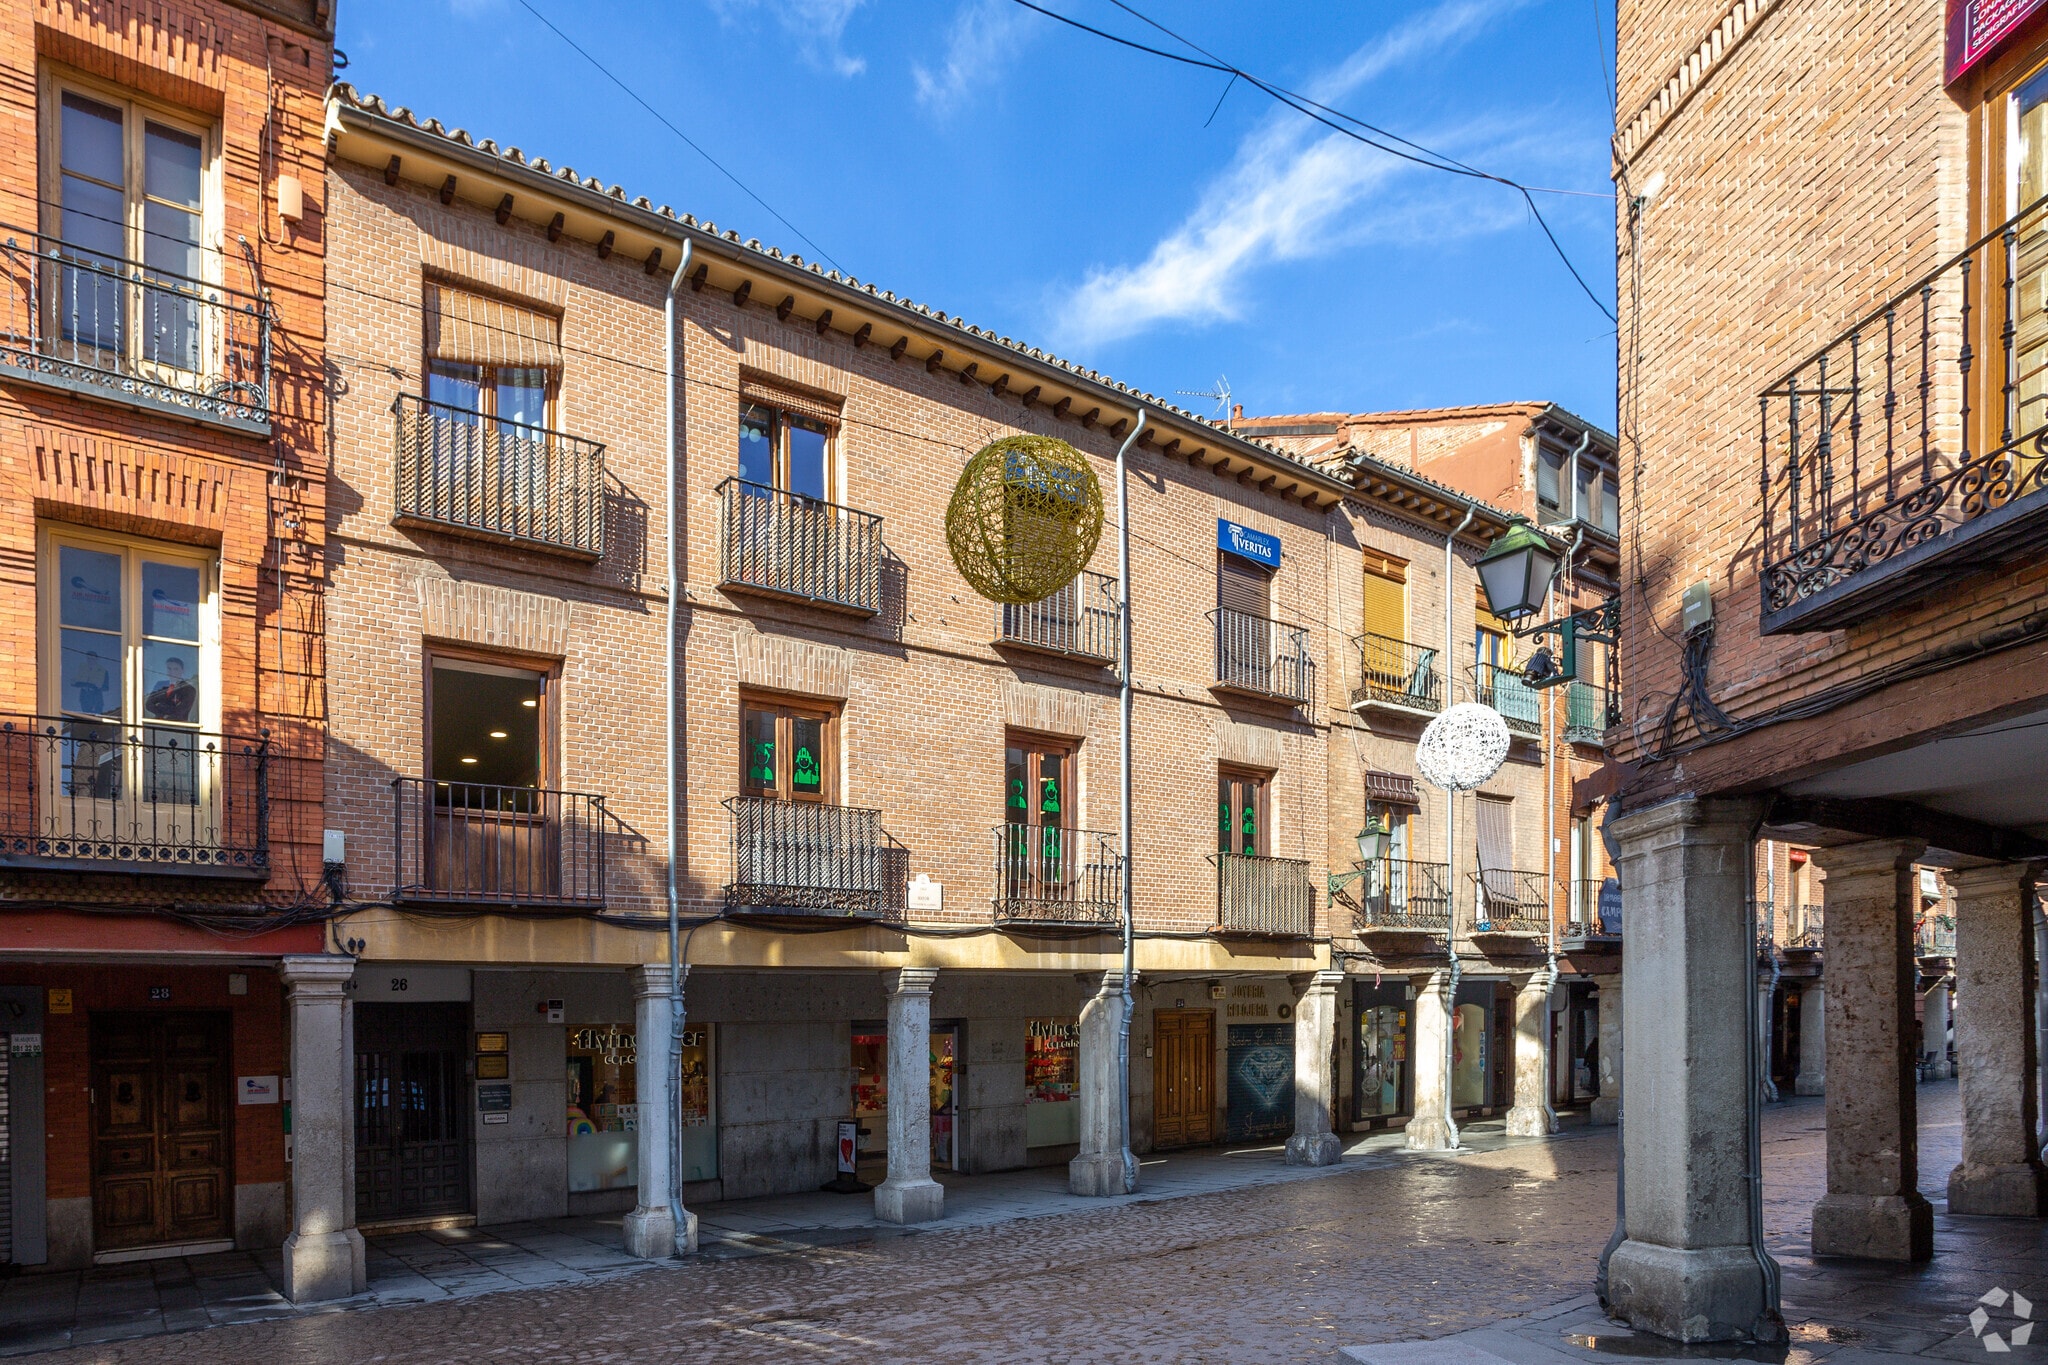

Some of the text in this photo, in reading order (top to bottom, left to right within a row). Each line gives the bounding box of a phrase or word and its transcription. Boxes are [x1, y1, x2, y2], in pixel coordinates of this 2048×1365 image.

[1239, 538, 1271, 558] VERITAS
[1601, 906, 1622, 918] CAMP
[391, 978, 408, 991] 26
[151, 987, 170, 999] 28
[577, 1029, 637, 1055] flyin
[605, 1055, 637, 1066] cope
